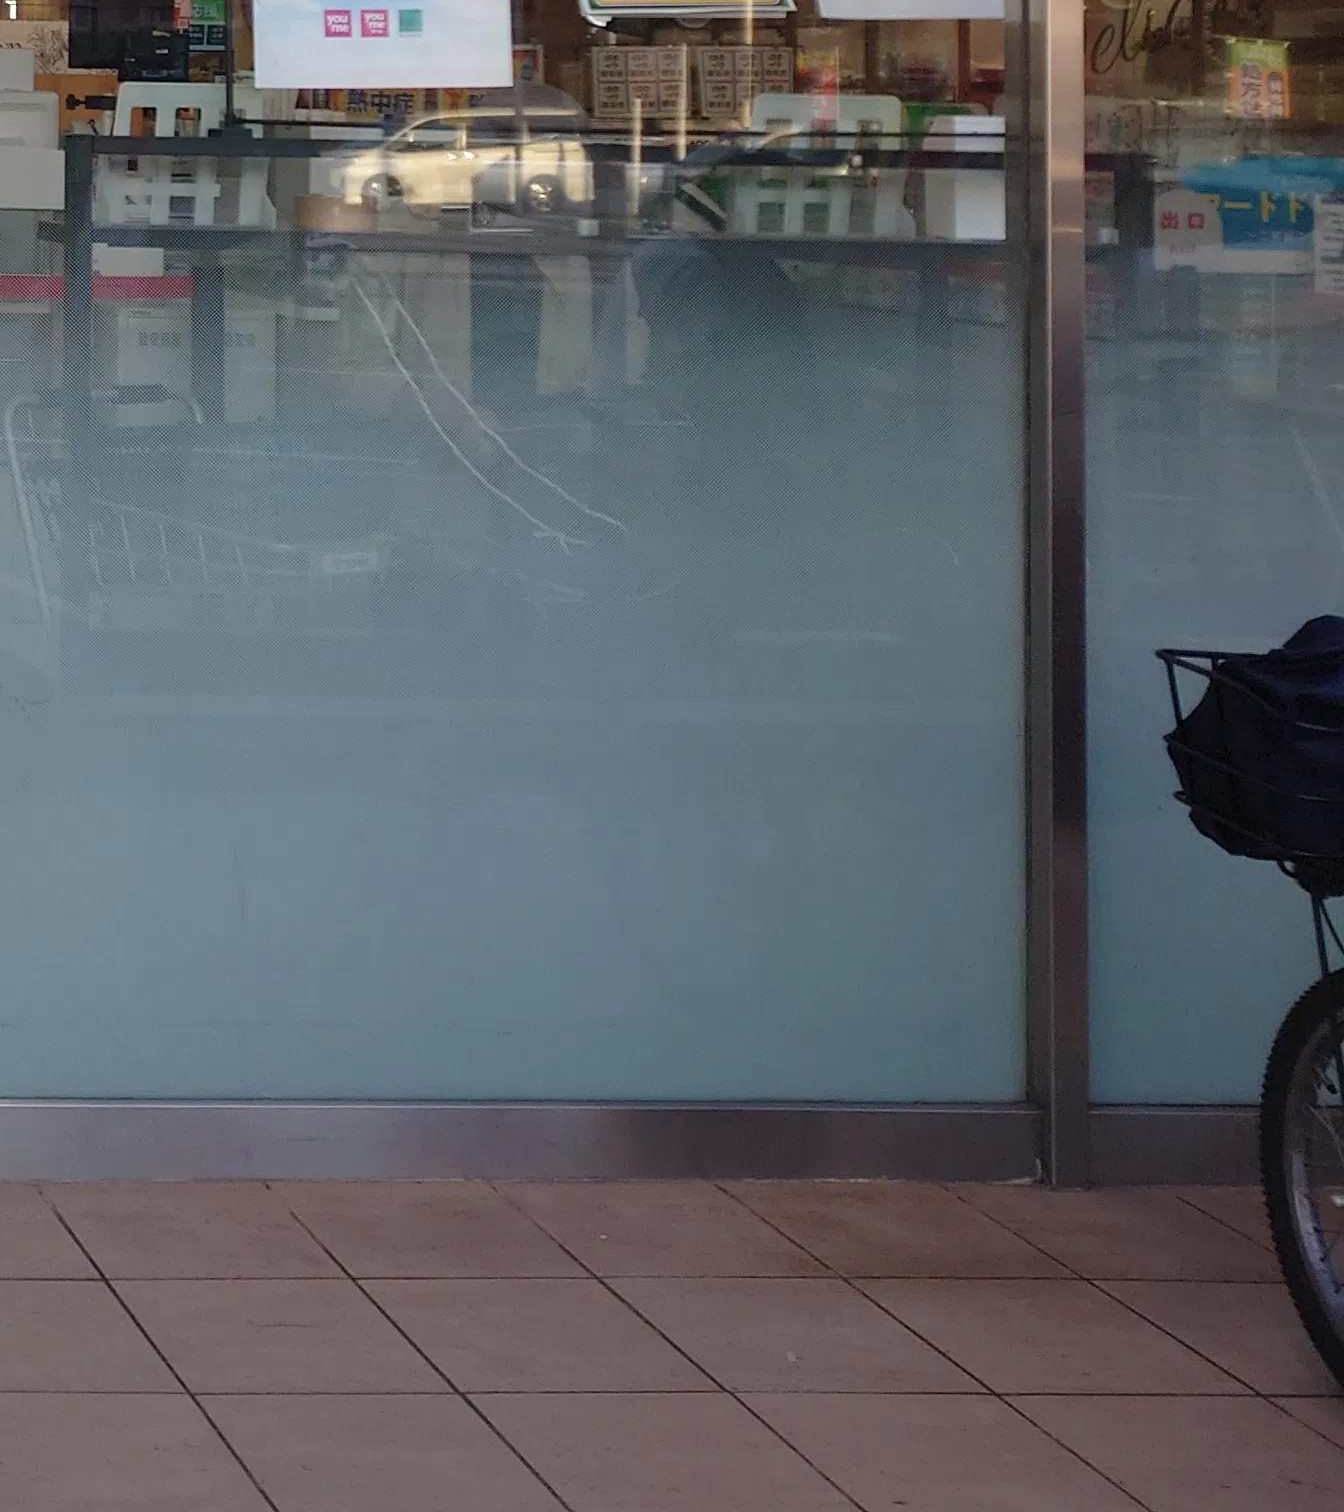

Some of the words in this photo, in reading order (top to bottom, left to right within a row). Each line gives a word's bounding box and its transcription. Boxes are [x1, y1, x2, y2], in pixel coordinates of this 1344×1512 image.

[326, 15, 349, 26] you
[365, 12, 385, 22] you
[331, 24, 350, 33] me
[368, 21, 386, 29] me
[1160, 211, 1205, 230] 出口
